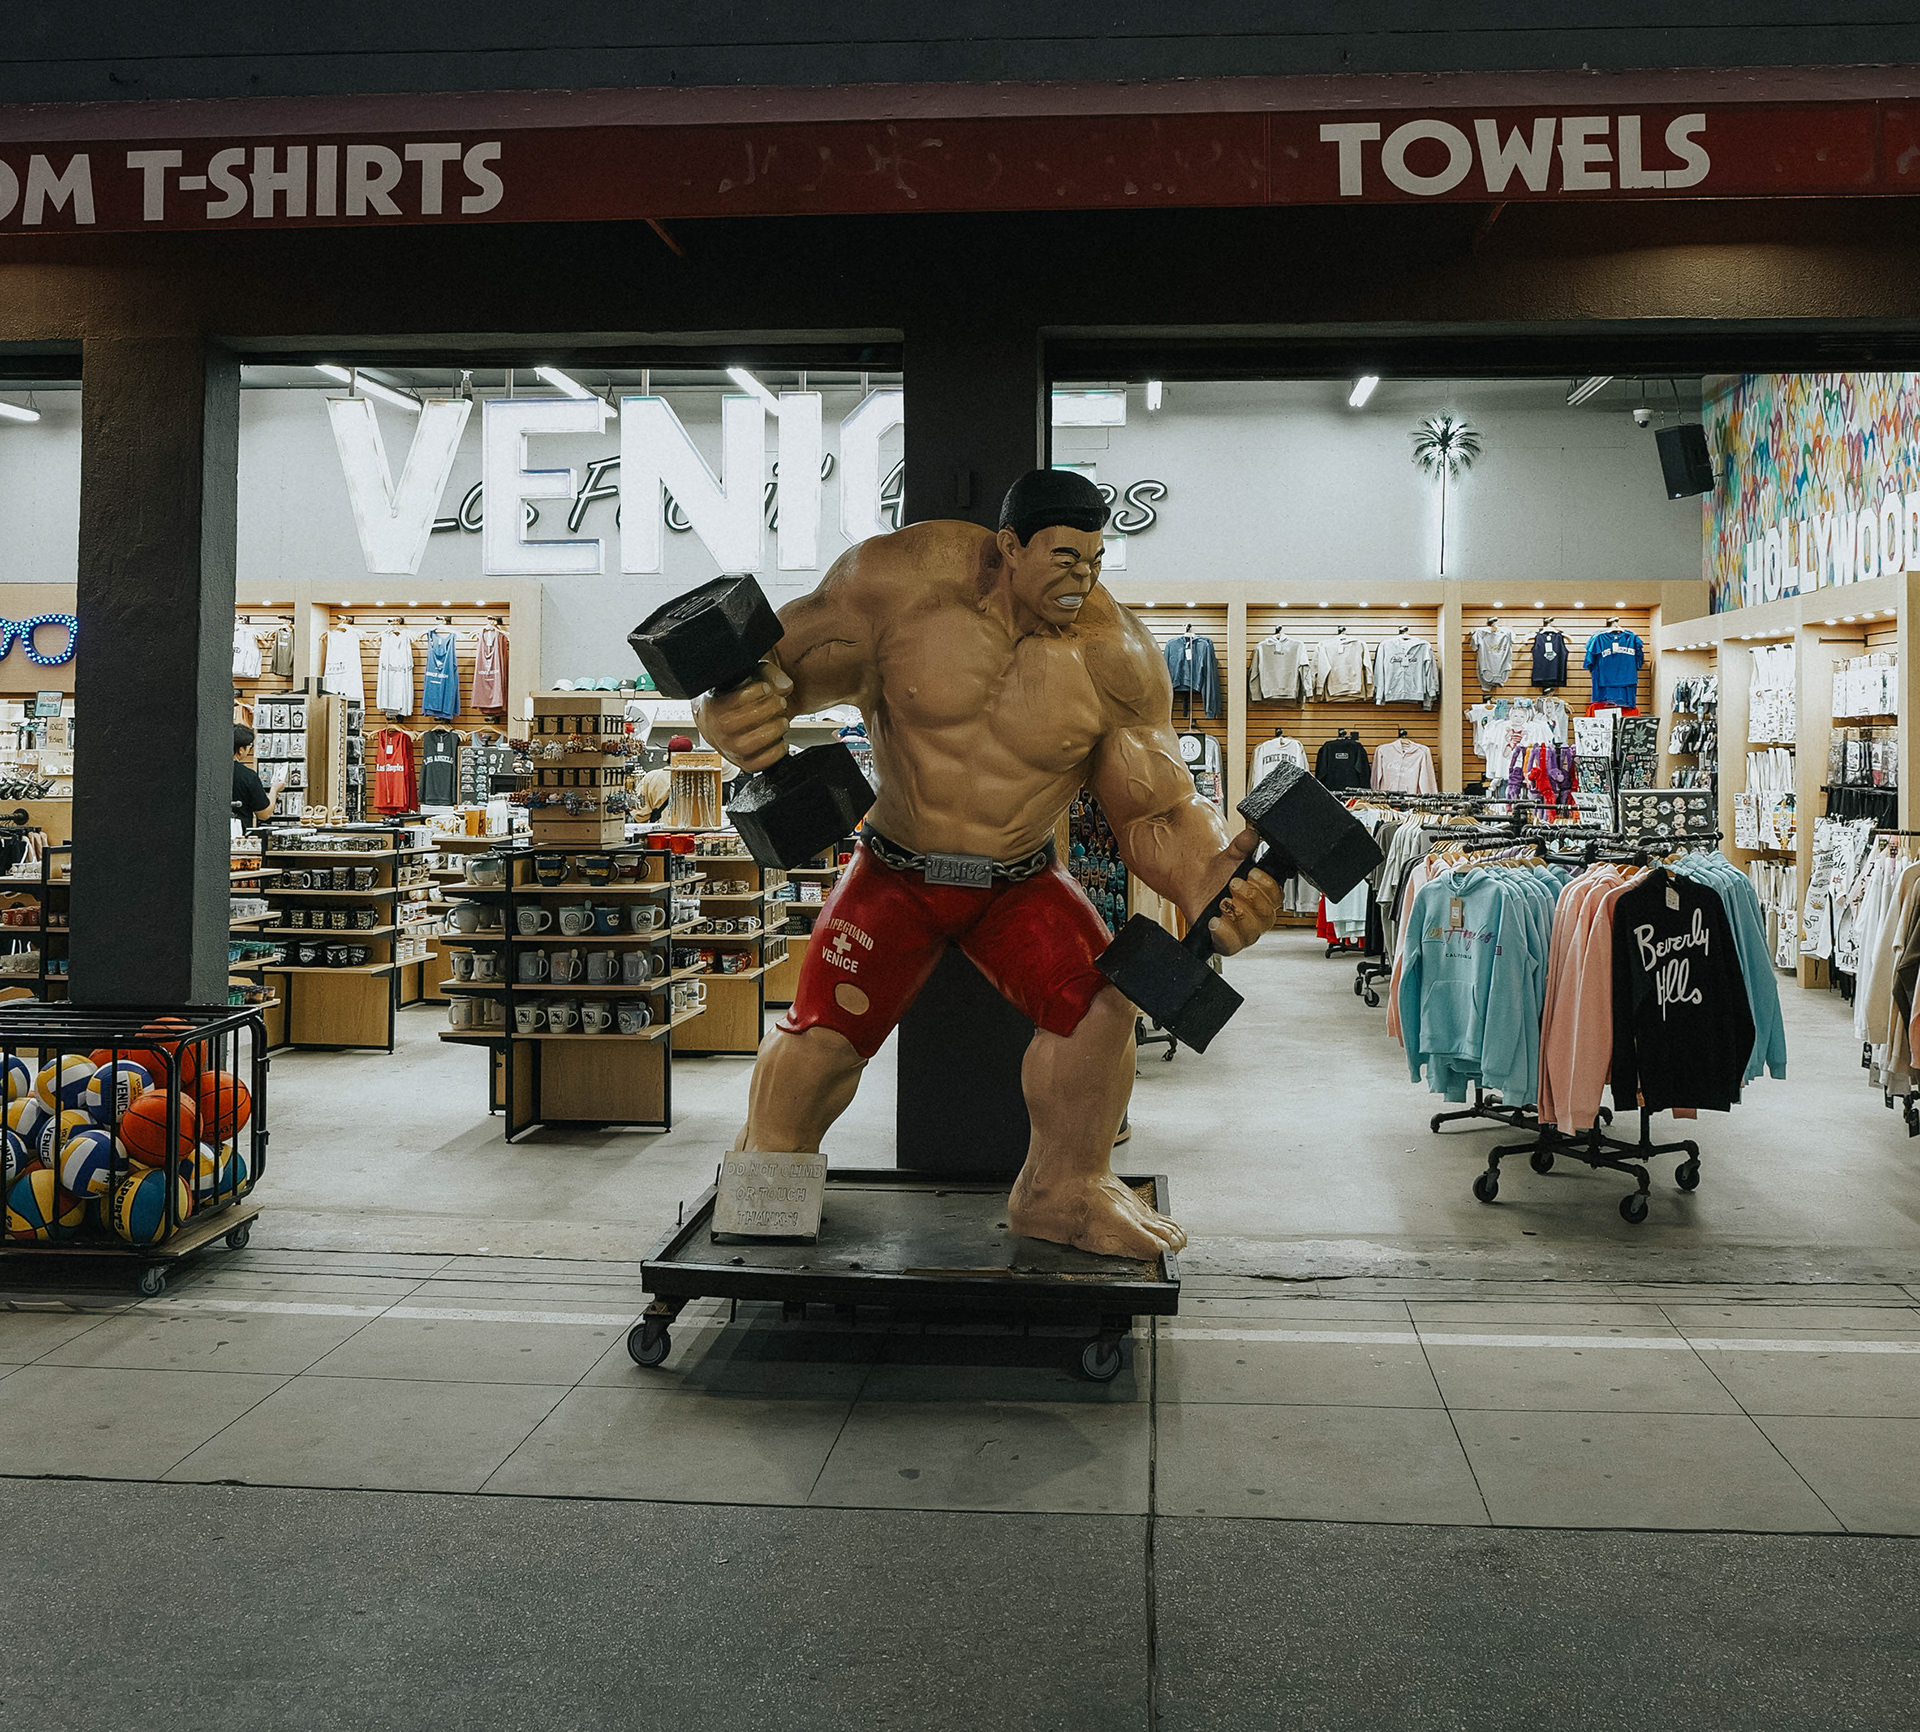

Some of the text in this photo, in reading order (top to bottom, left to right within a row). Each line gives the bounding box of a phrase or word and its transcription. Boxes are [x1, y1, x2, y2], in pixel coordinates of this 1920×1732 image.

[1319, 113, 1711, 196] TOWELS
[0, 141, 504, 225] M T-SHIRTS
[824, 918, 875, 951] LIFEGUARD
[1633, 908, 1710, 971] Beverly
[821, 945, 859, 974] VENICE
[116, 1079, 129, 1116] VENICE
[41, 1126, 57, 1163] VENICE
[727, 1162, 823, 1179] DO NOT CLIMB
[735, 1186, 807, 1202] OR TOUCH
[737, 1210, 799, 1227] THANKS!
